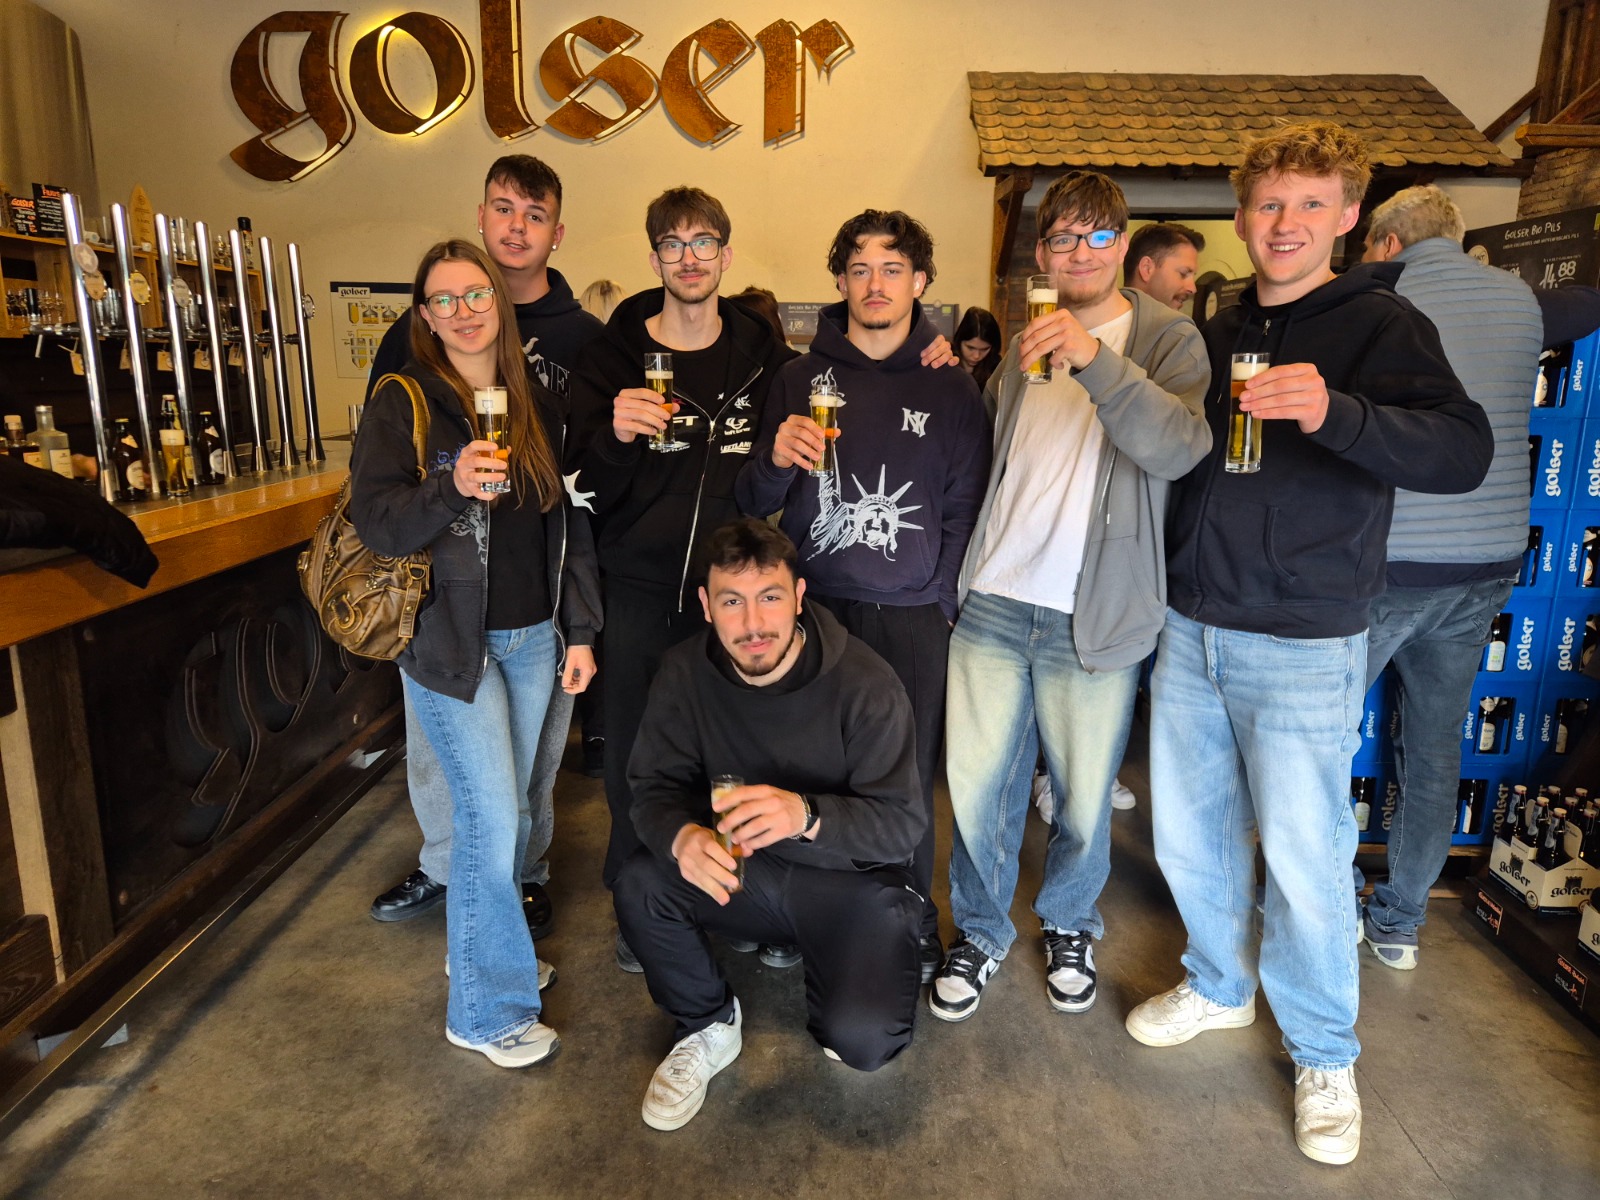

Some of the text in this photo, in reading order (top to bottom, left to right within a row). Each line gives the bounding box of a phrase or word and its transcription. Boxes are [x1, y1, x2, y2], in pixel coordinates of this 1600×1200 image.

[229, 0, 854, 183] golser
[1504, 228, 1530, 241] GOLSER
[1544, 221, 1562, 234] PILS
[340, 287, 368, 297] golser
[1572, 358, 1584, 392] golser
[901, 407, 931, 438] NY
[1545, 438, 1564, 497] golser
[1542, 541, 1554, 573] golser
[1568, 542, 1579, 573] golser
[1517, 616, 1535, 671] golser
[1557, 617, 1576, 672] golser
[1366, 709, 1376, 739] golser
[1464, 711, 1475, 740] golser
[1515, 712, 1526, 741] golser
[1540, 713, 1551, 742] golser
[1499, 861, 1531, 887] golser
[1550, 887, 1593, 898] golser
